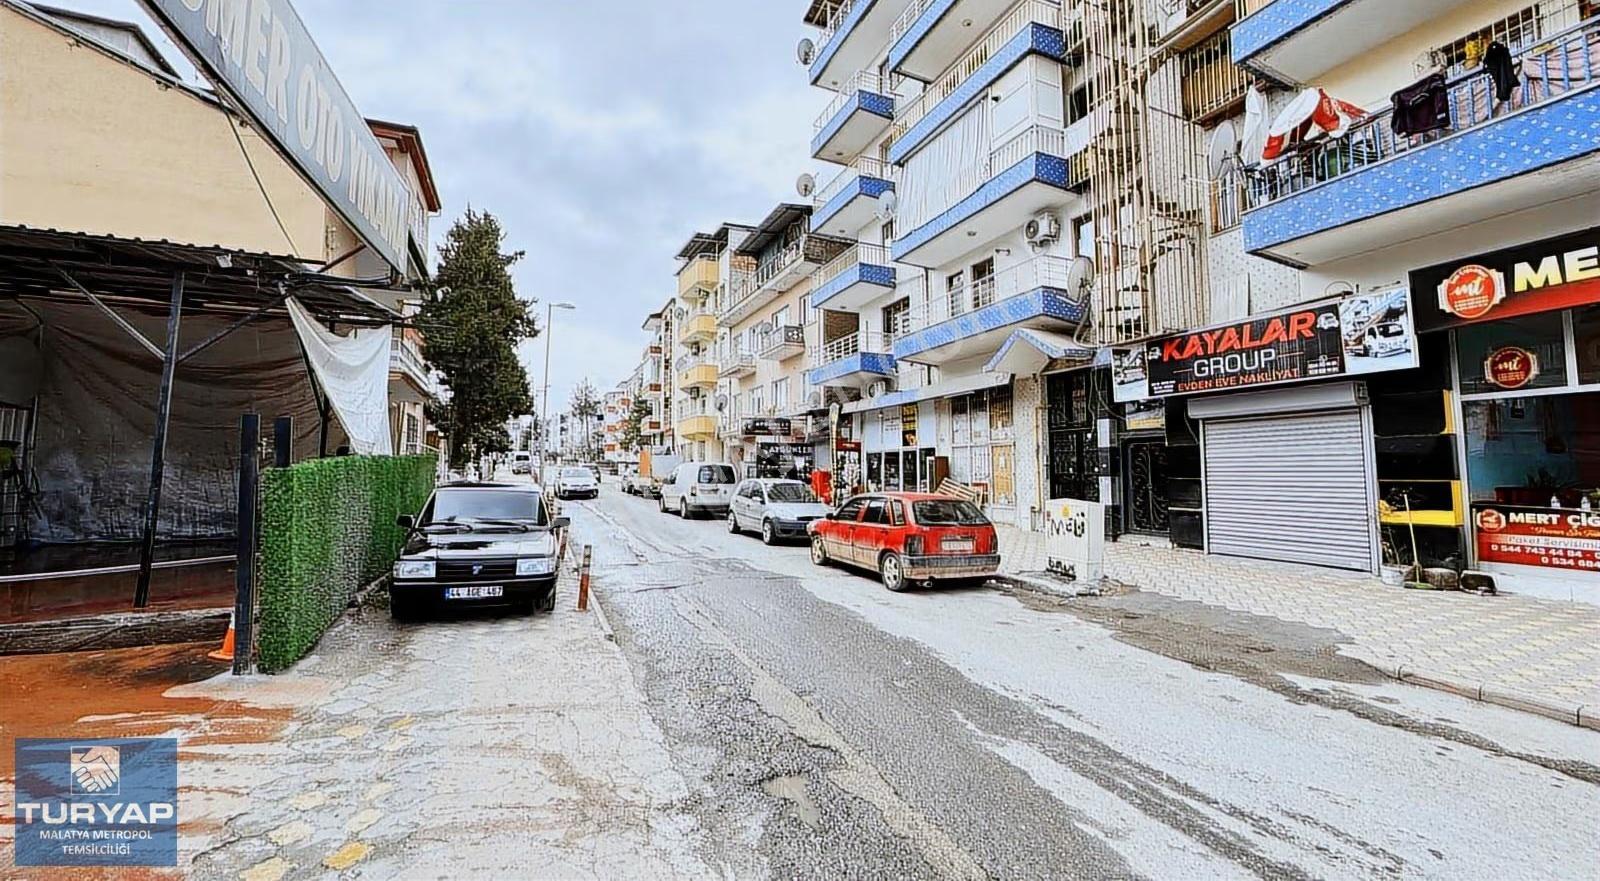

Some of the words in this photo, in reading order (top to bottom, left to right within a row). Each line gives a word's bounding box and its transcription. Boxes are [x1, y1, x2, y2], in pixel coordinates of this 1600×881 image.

[182, 0, 289, 124] MER
[297, 64, 344, 182] OTO
[1163, 310, 1317, 362] KAYALAR
[1194, 349, 1275, 377] GROUP
[1178, 380, 1212, 392] EVDEN
[1215, 377, 1237, 388] EVE
[1509, 513, 1560, 525] MERT
